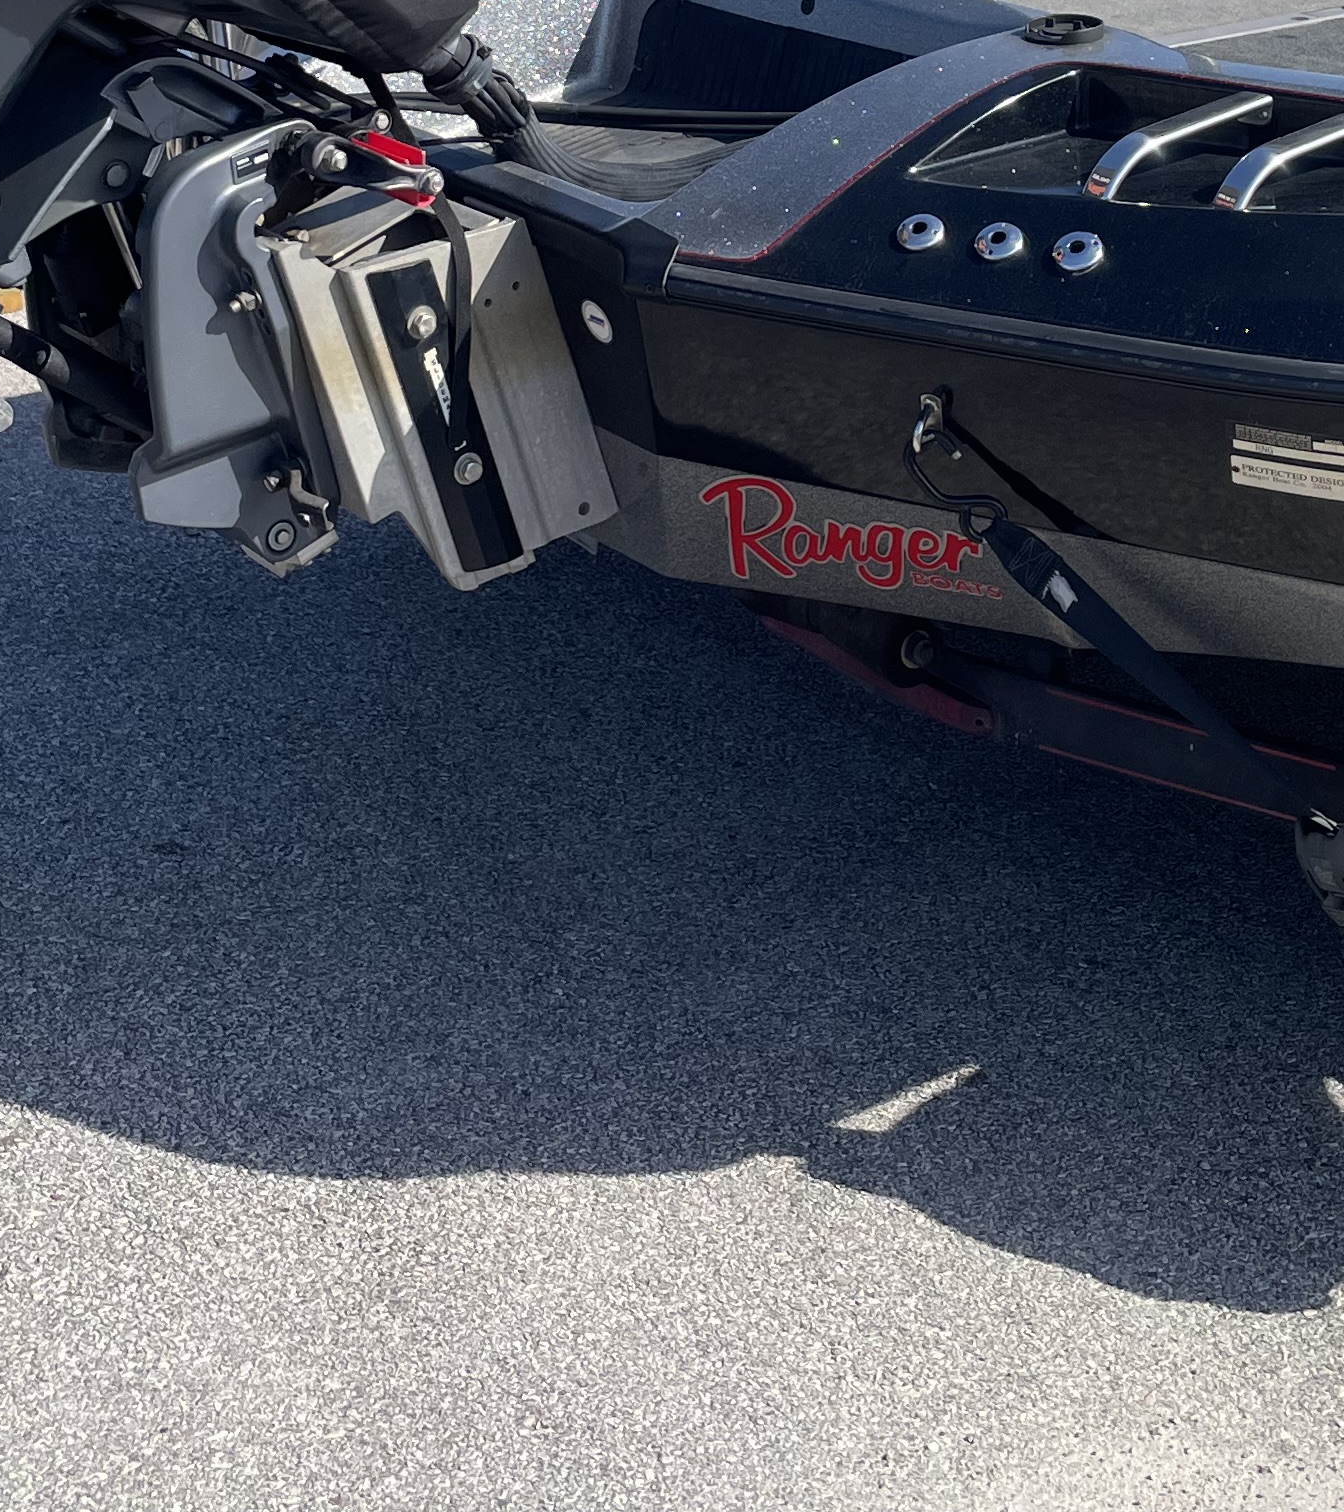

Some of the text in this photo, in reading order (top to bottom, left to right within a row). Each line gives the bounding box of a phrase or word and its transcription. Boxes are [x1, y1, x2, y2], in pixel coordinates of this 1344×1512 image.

[1241, 463, 1308, 481] PROTECTED
[699, 474, 984, 590] Ranger
[910, 570, 1003, 600] BOATS
